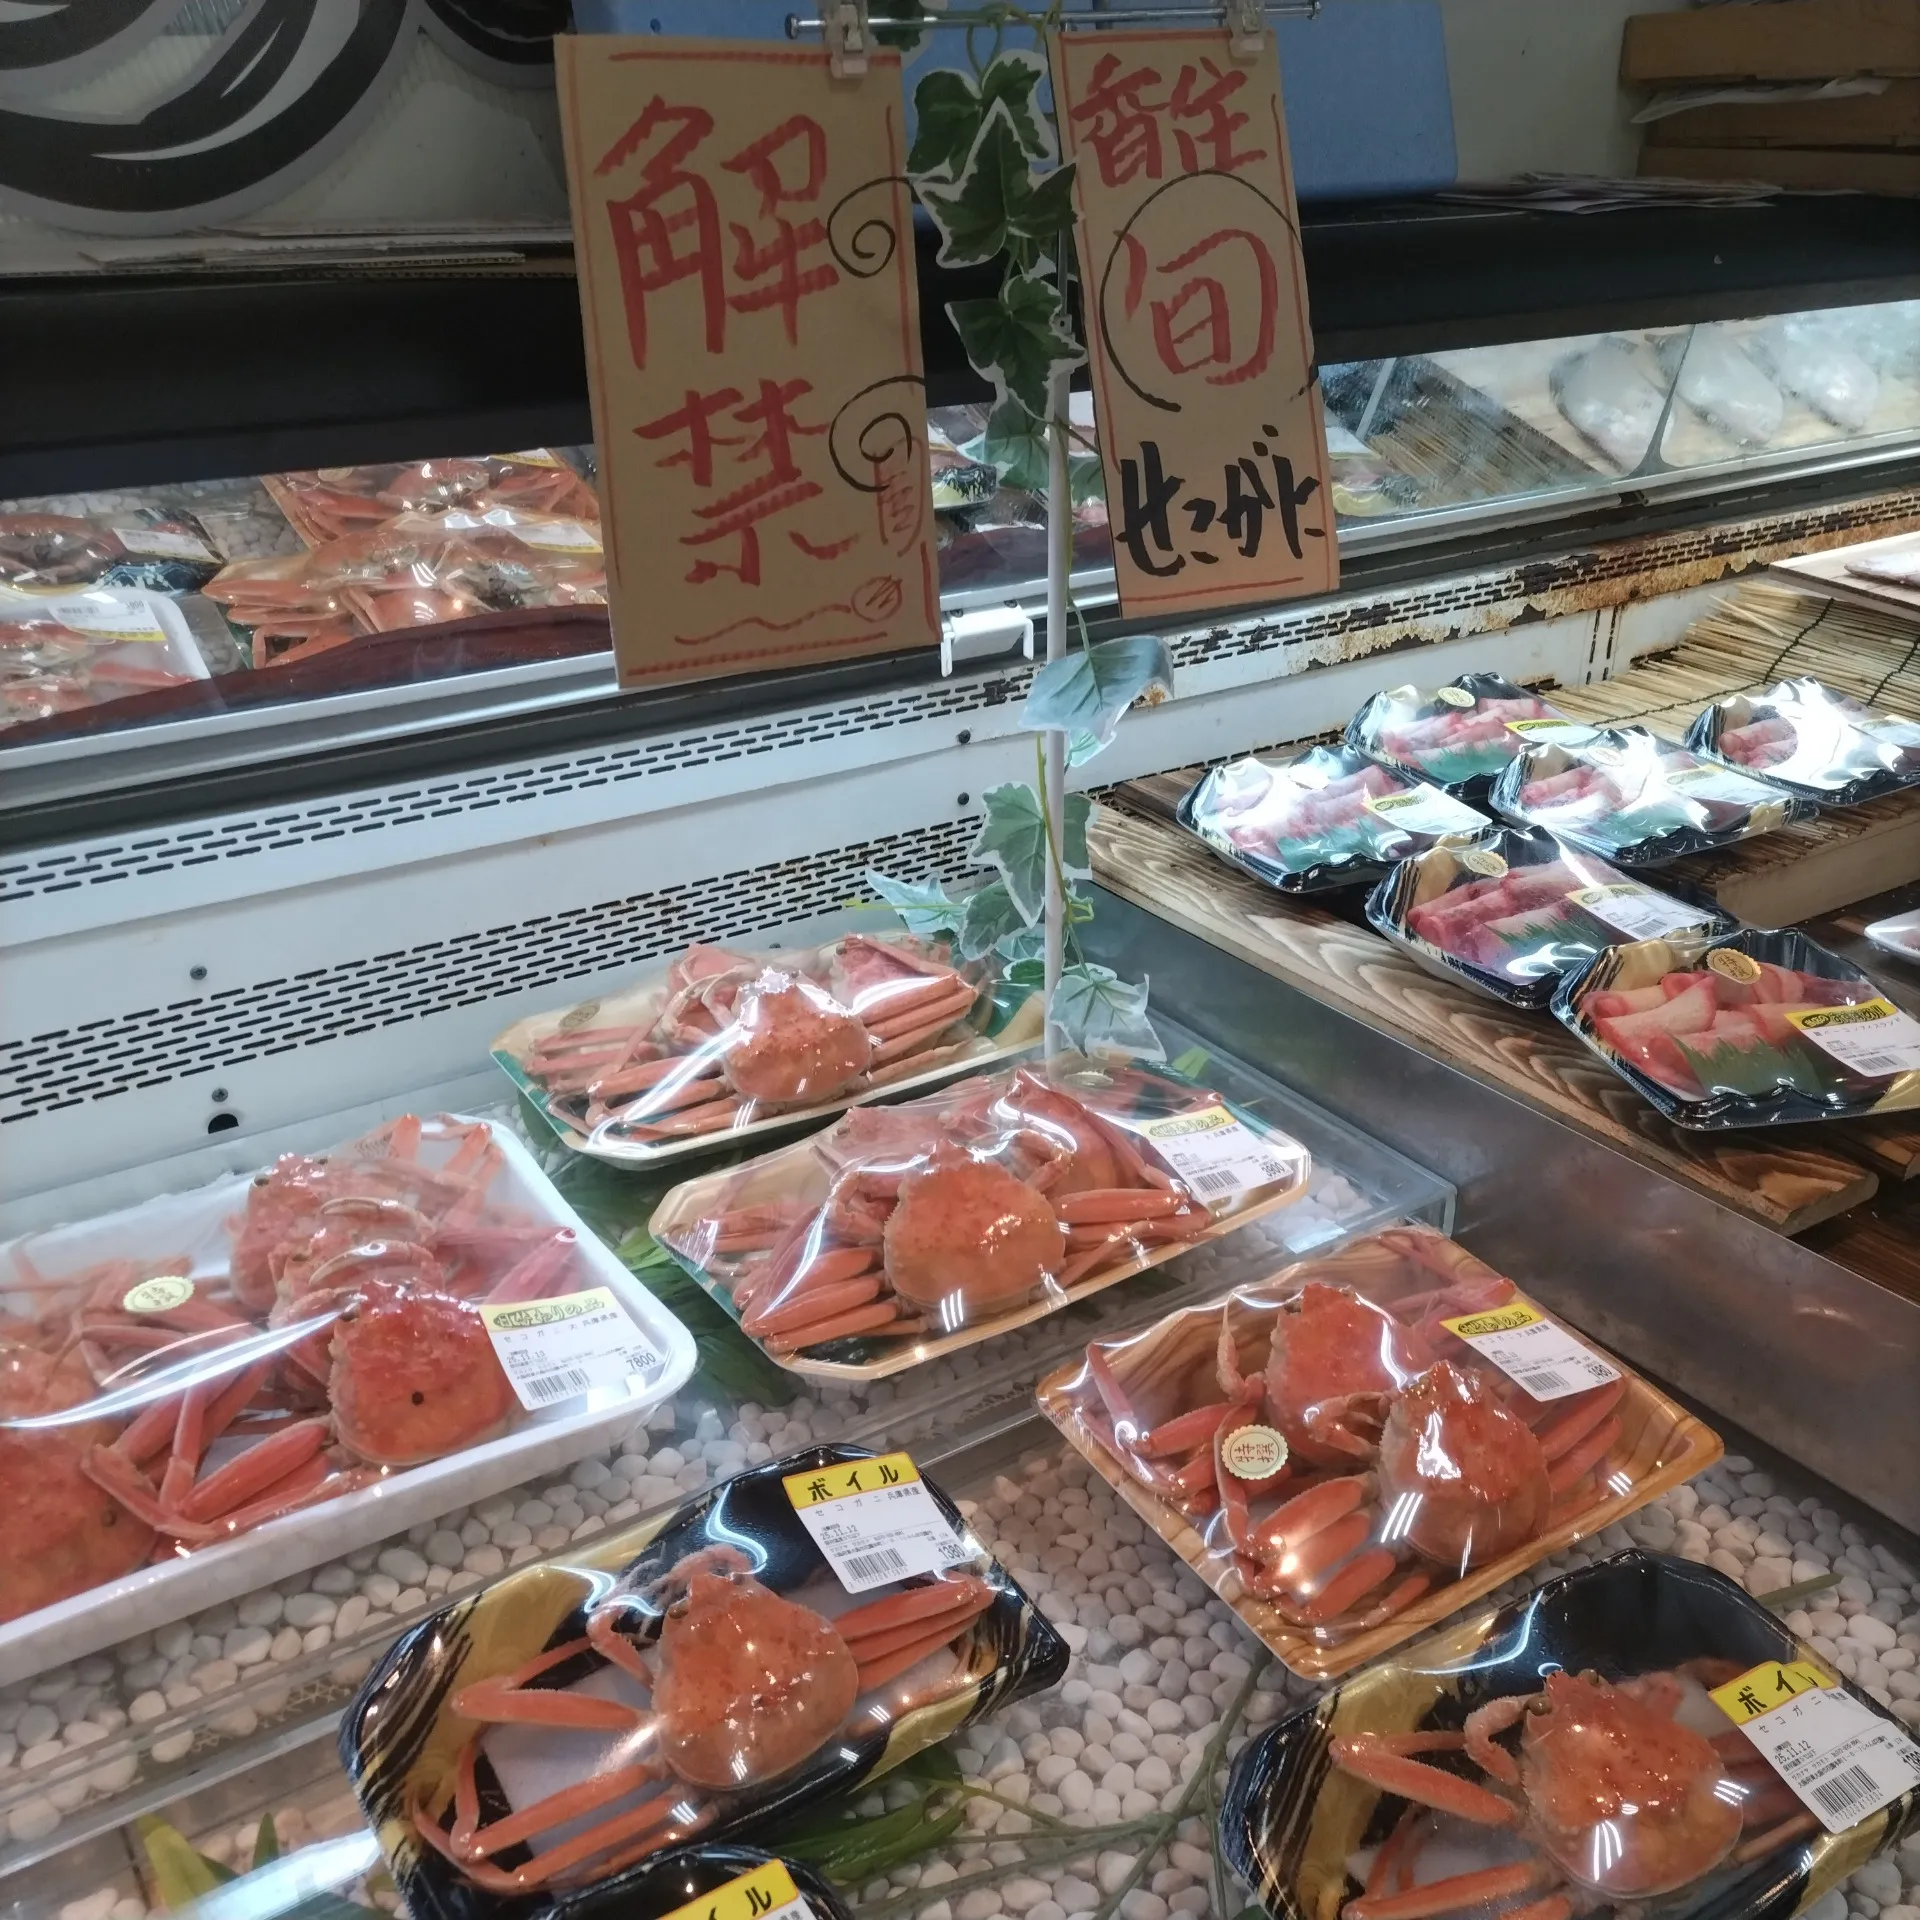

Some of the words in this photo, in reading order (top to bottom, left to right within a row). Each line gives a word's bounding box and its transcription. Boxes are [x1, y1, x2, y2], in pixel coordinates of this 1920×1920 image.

[1113, 228, 1279, 386] 旬
[595, 95, 861, 587] 解禁
[1116, 424, 1326, 578] せこがに
[1261, 1162, 1286, 1178] 3900
[626, 1352, 656, 1371] 7800
[807, 1464, 899, 1502] ボイル
[937, 1544, 966, 1561] 1380
[1775, 1740, 1812, 1765] 25.11.12
